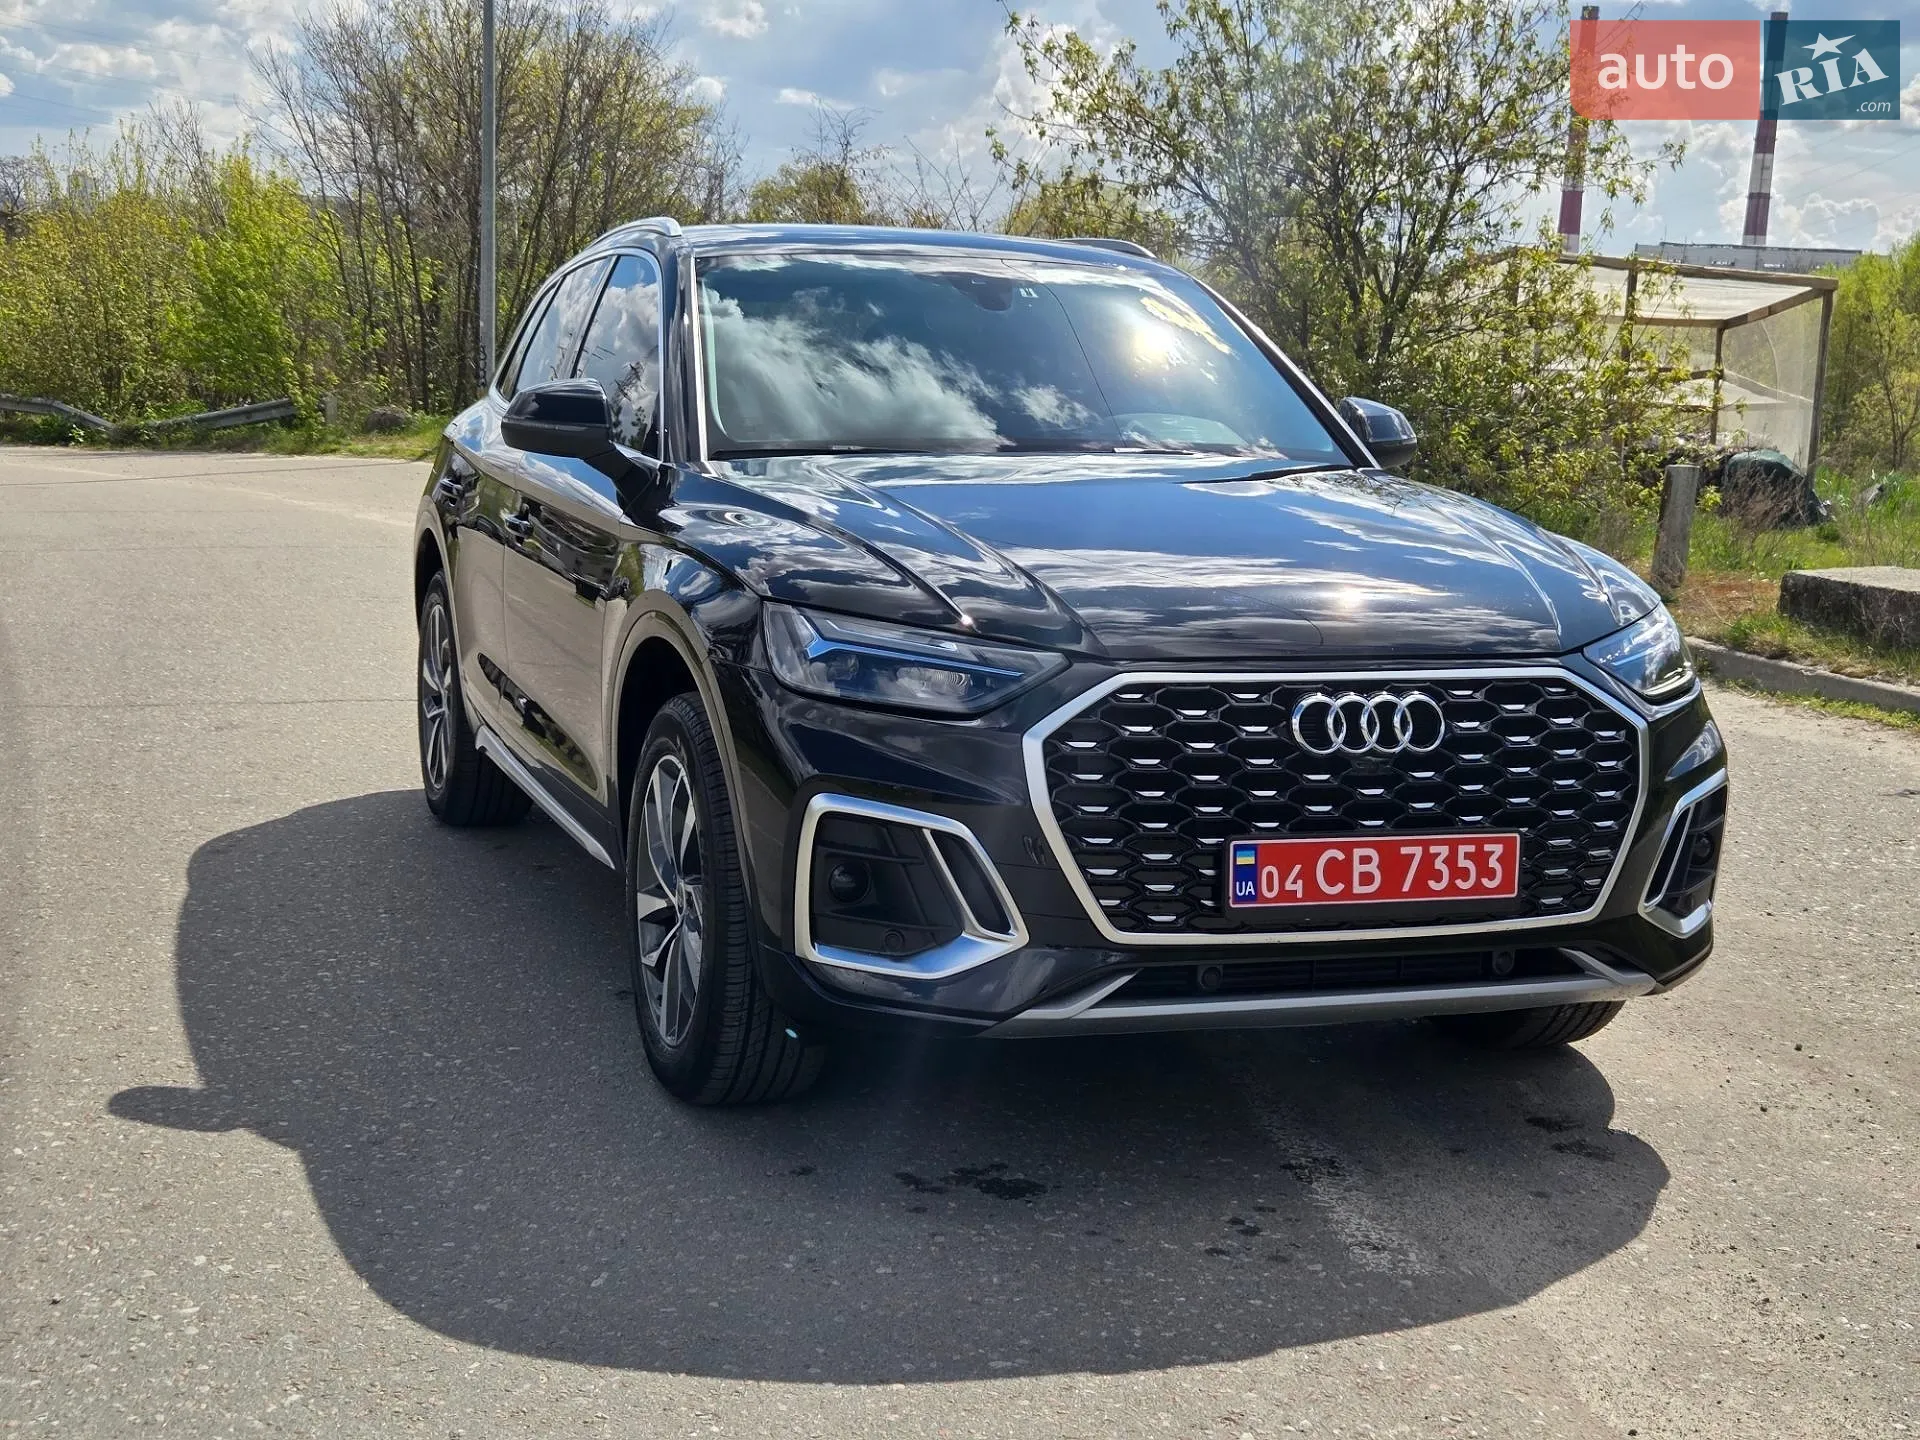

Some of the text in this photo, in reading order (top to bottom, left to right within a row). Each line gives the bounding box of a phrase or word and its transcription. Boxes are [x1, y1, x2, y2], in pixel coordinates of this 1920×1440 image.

[1261, 843, 1504, 898] 04 CB 7353
[1236, 881, 1256, 896] UA
